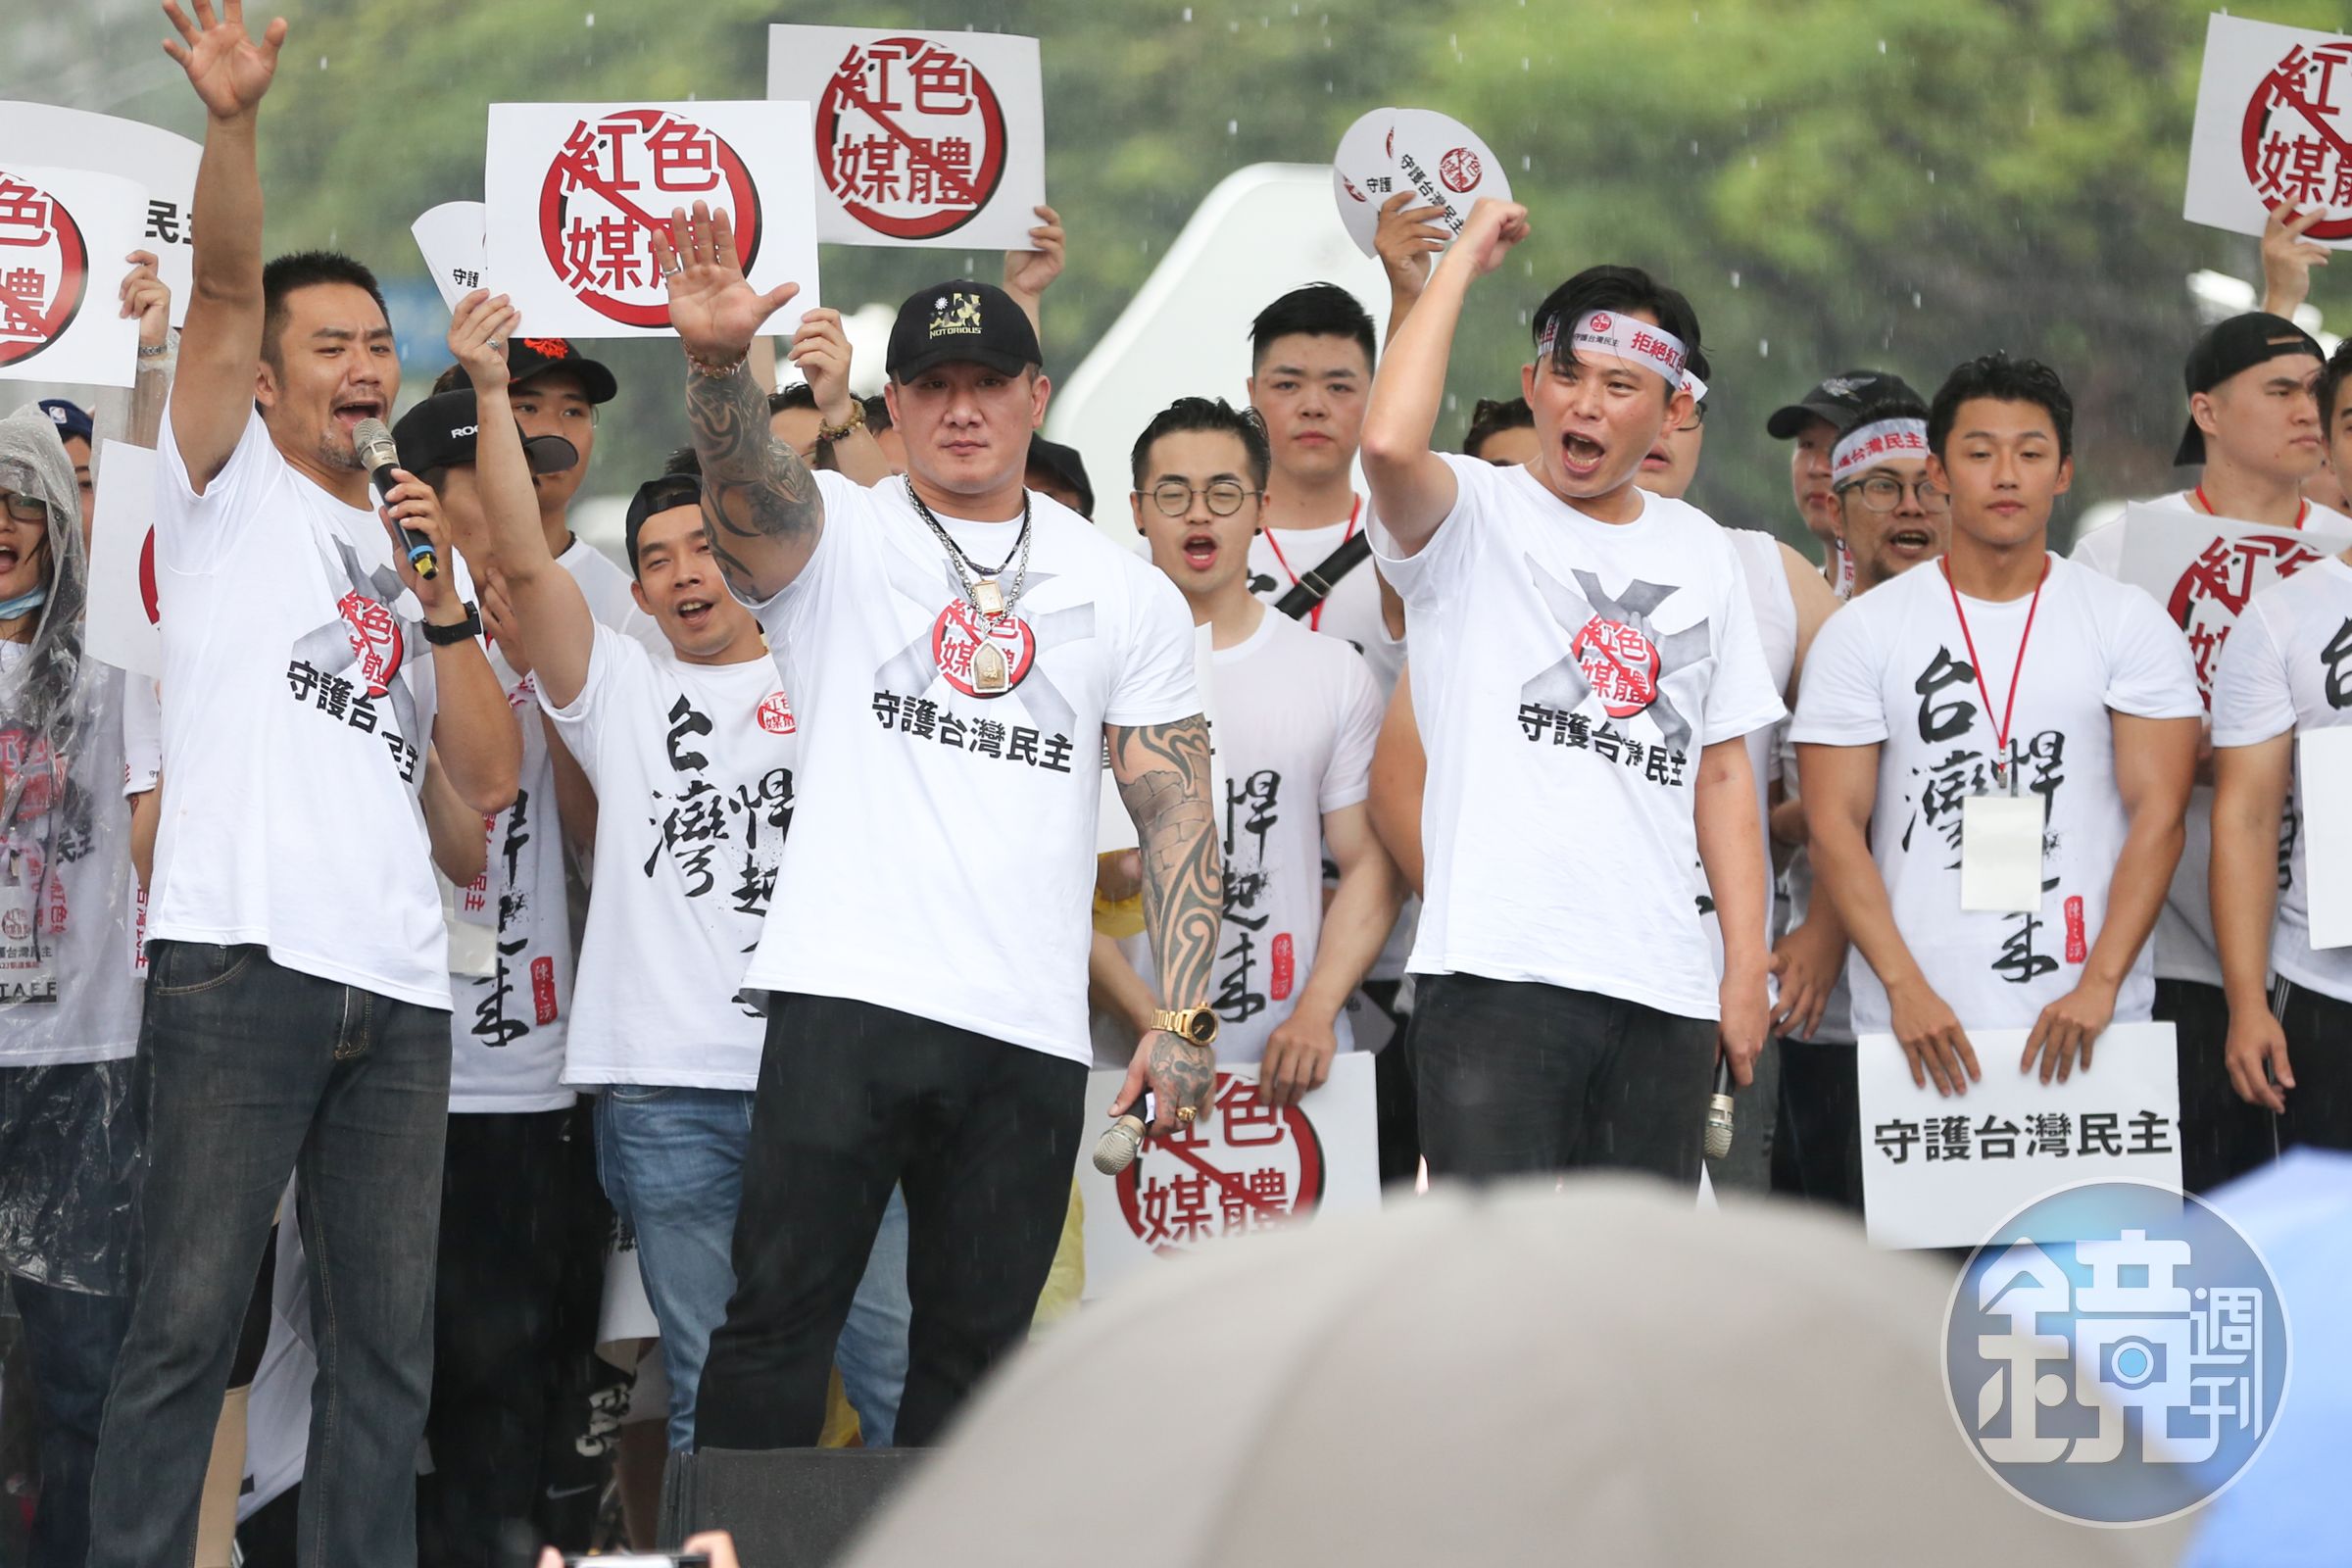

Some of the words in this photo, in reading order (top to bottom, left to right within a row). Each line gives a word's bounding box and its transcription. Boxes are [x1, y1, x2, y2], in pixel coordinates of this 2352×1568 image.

[839, 44, 973, 116] 紅色
[564, 119, 720, 193] 紅色
[837, 133, 980, 205] 媒體
[0, 178, 52, 247] 色
[145, 199, 193, 245] 民
[929, 326, 982, 340] NOTORIOUS
[871, 689, 1075, 774] 守護台灣民主
[1874, 1109, 2174, 1165] 守護台灣民主
[1143, 1167, 1289, 1245] 媒體
